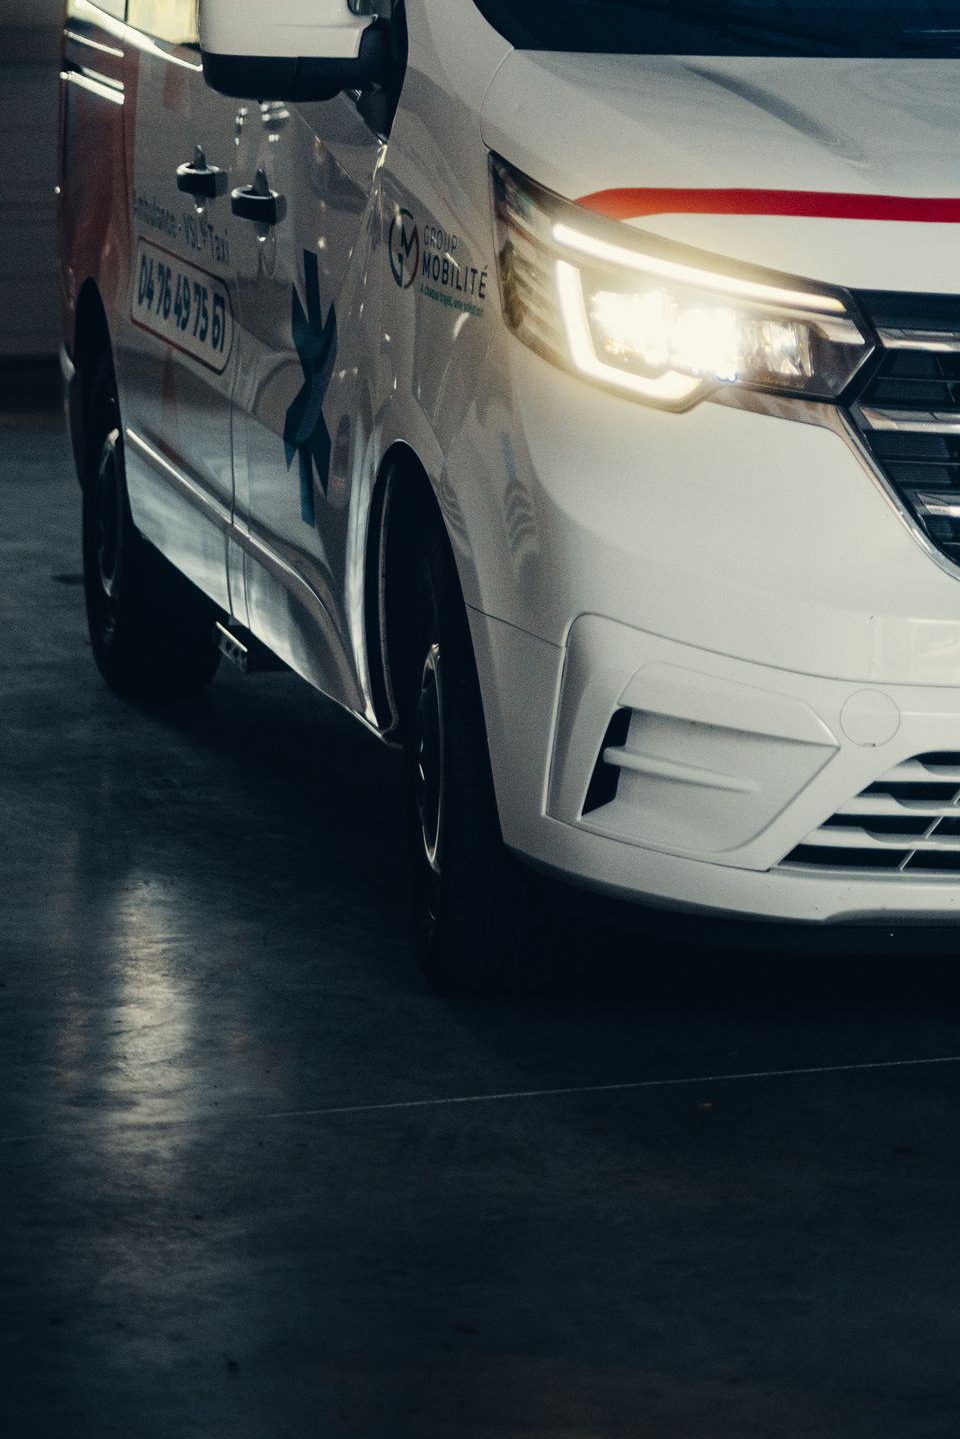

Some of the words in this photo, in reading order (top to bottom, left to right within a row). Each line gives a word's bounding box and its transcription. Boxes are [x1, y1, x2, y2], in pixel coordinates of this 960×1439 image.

[138, 253, 154, 311] 04
[156, 261, 172, 321] 76
[174, 272, 191, 331] 49
[193, 282, 208, 343] 75
[422, 250, 488, 299] MOBILITÉ
